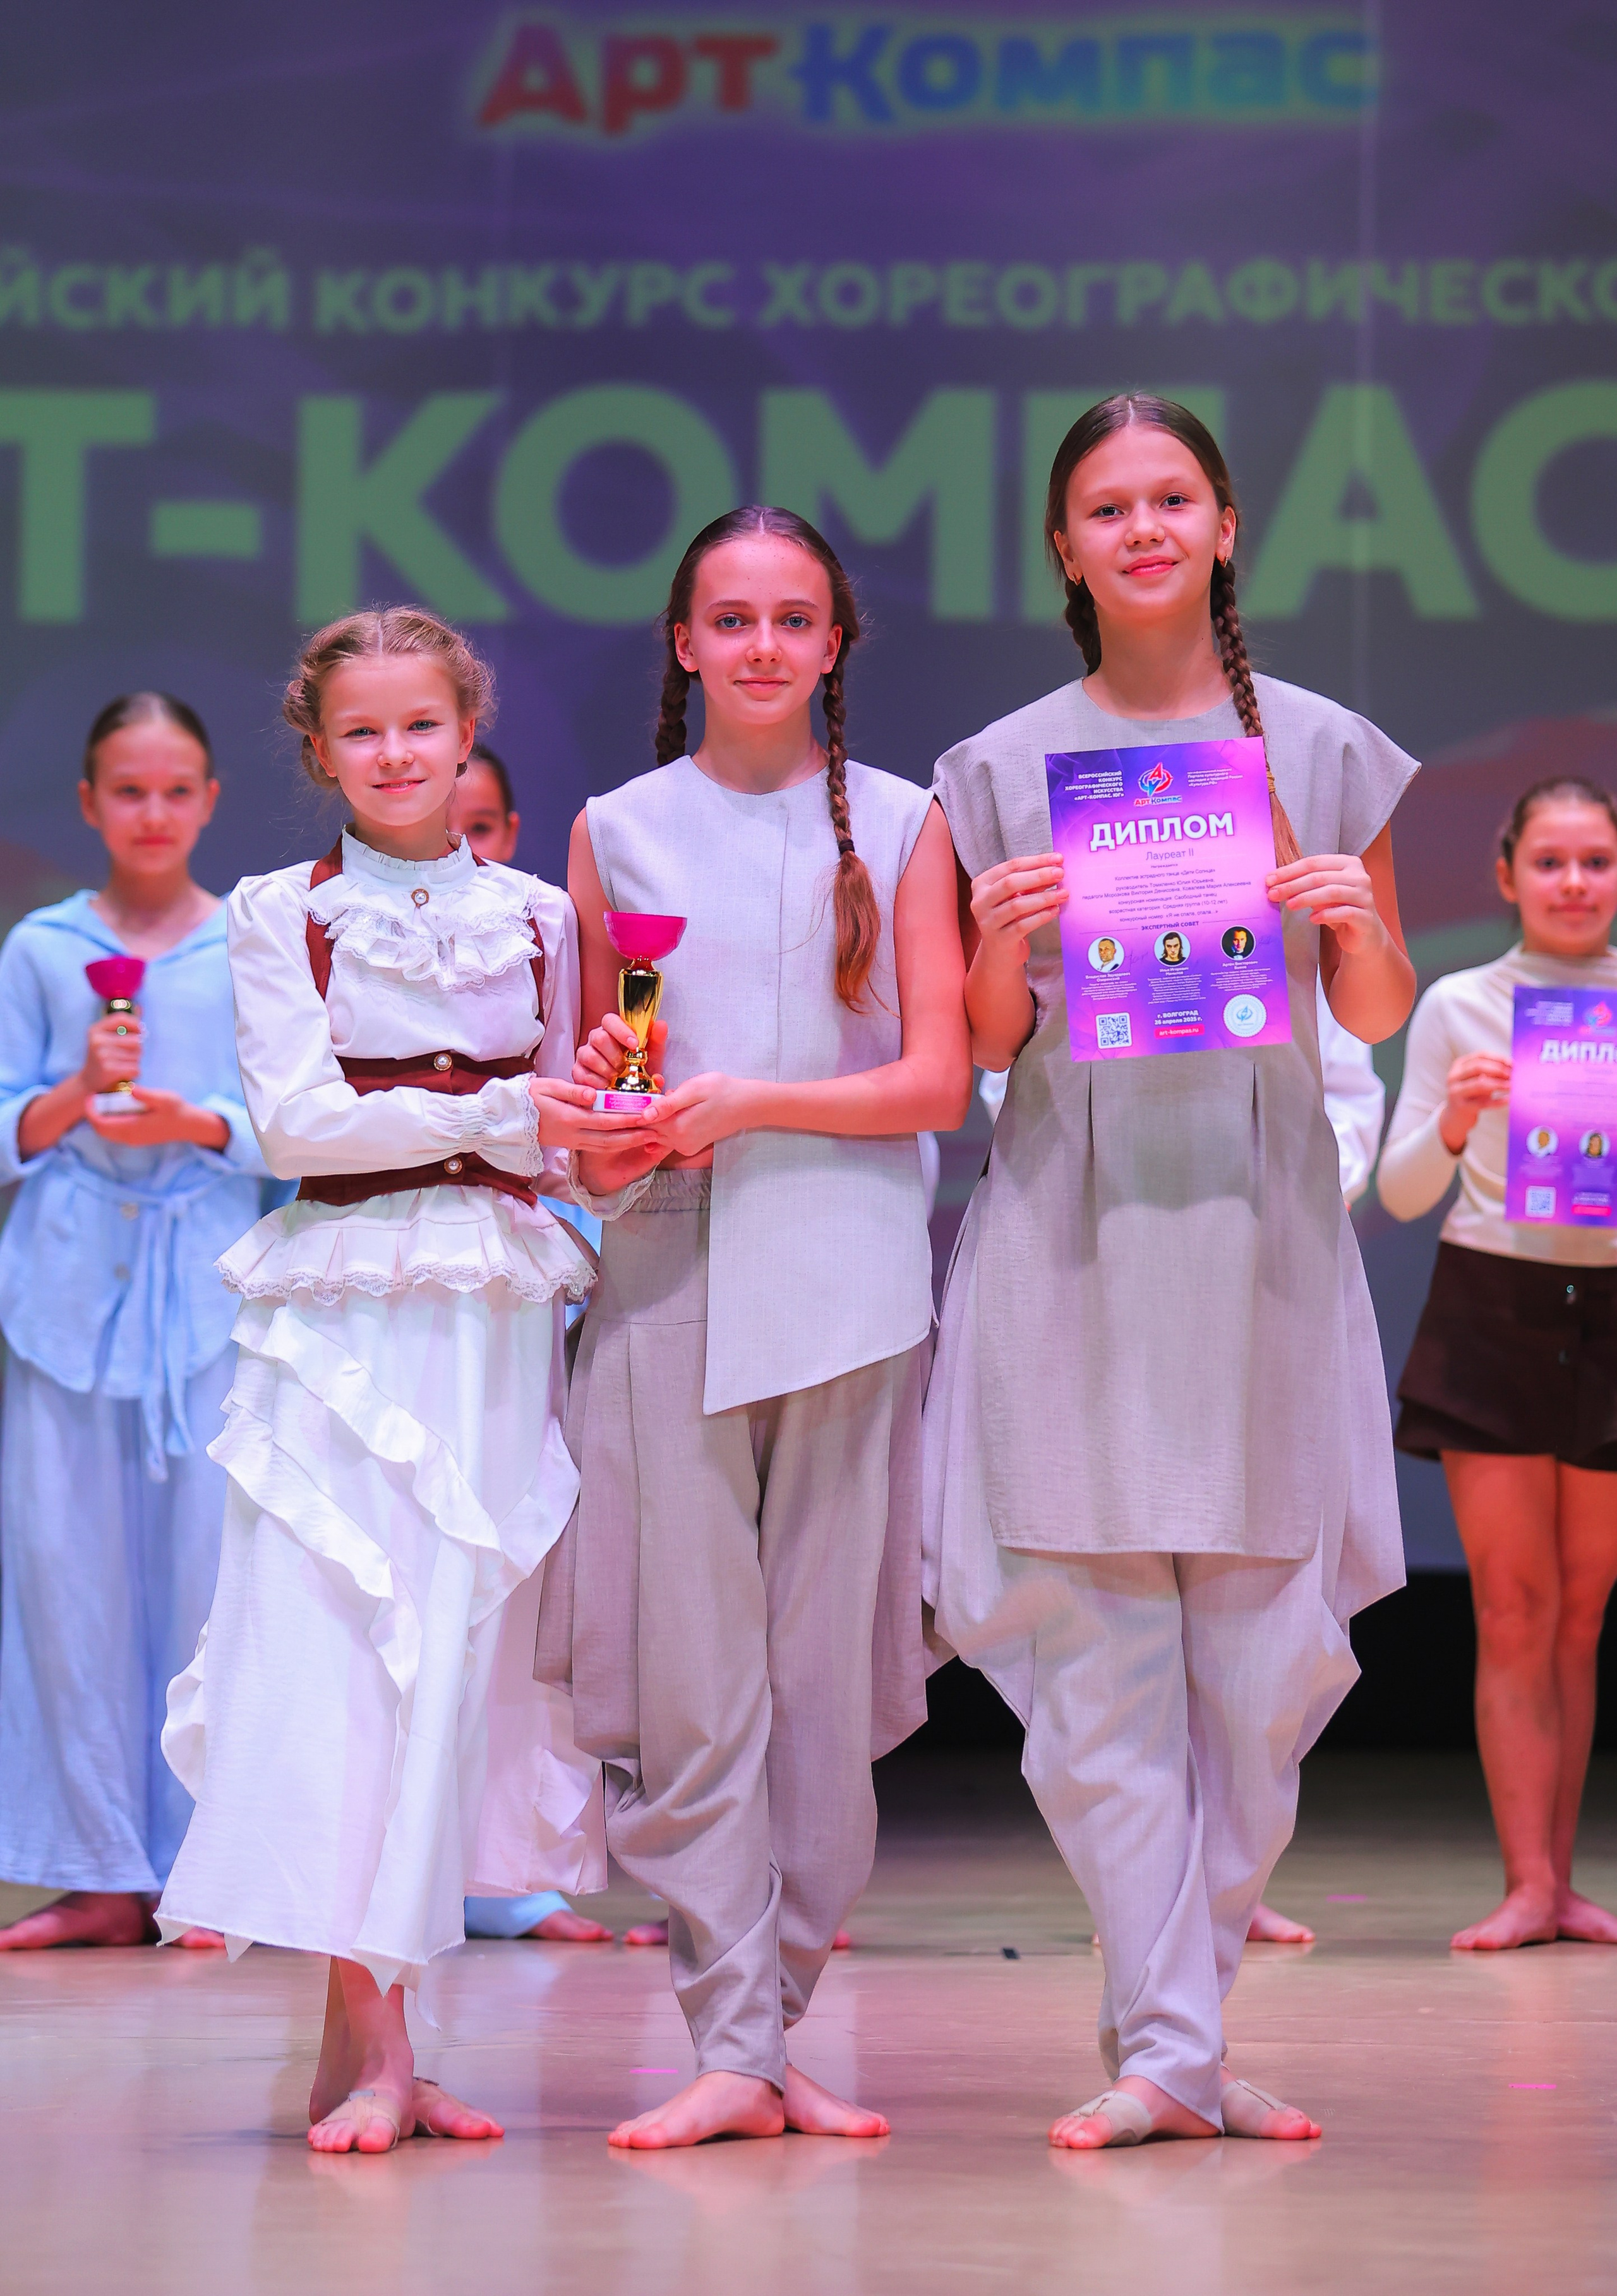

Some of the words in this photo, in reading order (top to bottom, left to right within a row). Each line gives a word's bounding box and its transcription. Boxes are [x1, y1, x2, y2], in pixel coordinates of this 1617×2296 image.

[317, 260, 736, 335] КОНКУРС
[1078, 770, 1122, 779] ВСЕРОССИЙСКИЙ
[1065, 782, 1123, 791] ХОРЕОГРАФИЧЕСКОГО
[1089, 811, 1235, 852] ДИПЛОМ
[1146, 851, 1186, 861] Лауреат
[1141, 922, 1179, 931] ЭКСПЕРТНЫЙ
[1163, 1010, 1199, 1018] ВОЛГОГРАД
[1539, 1039, 1617, 1065] ДИПЛ
